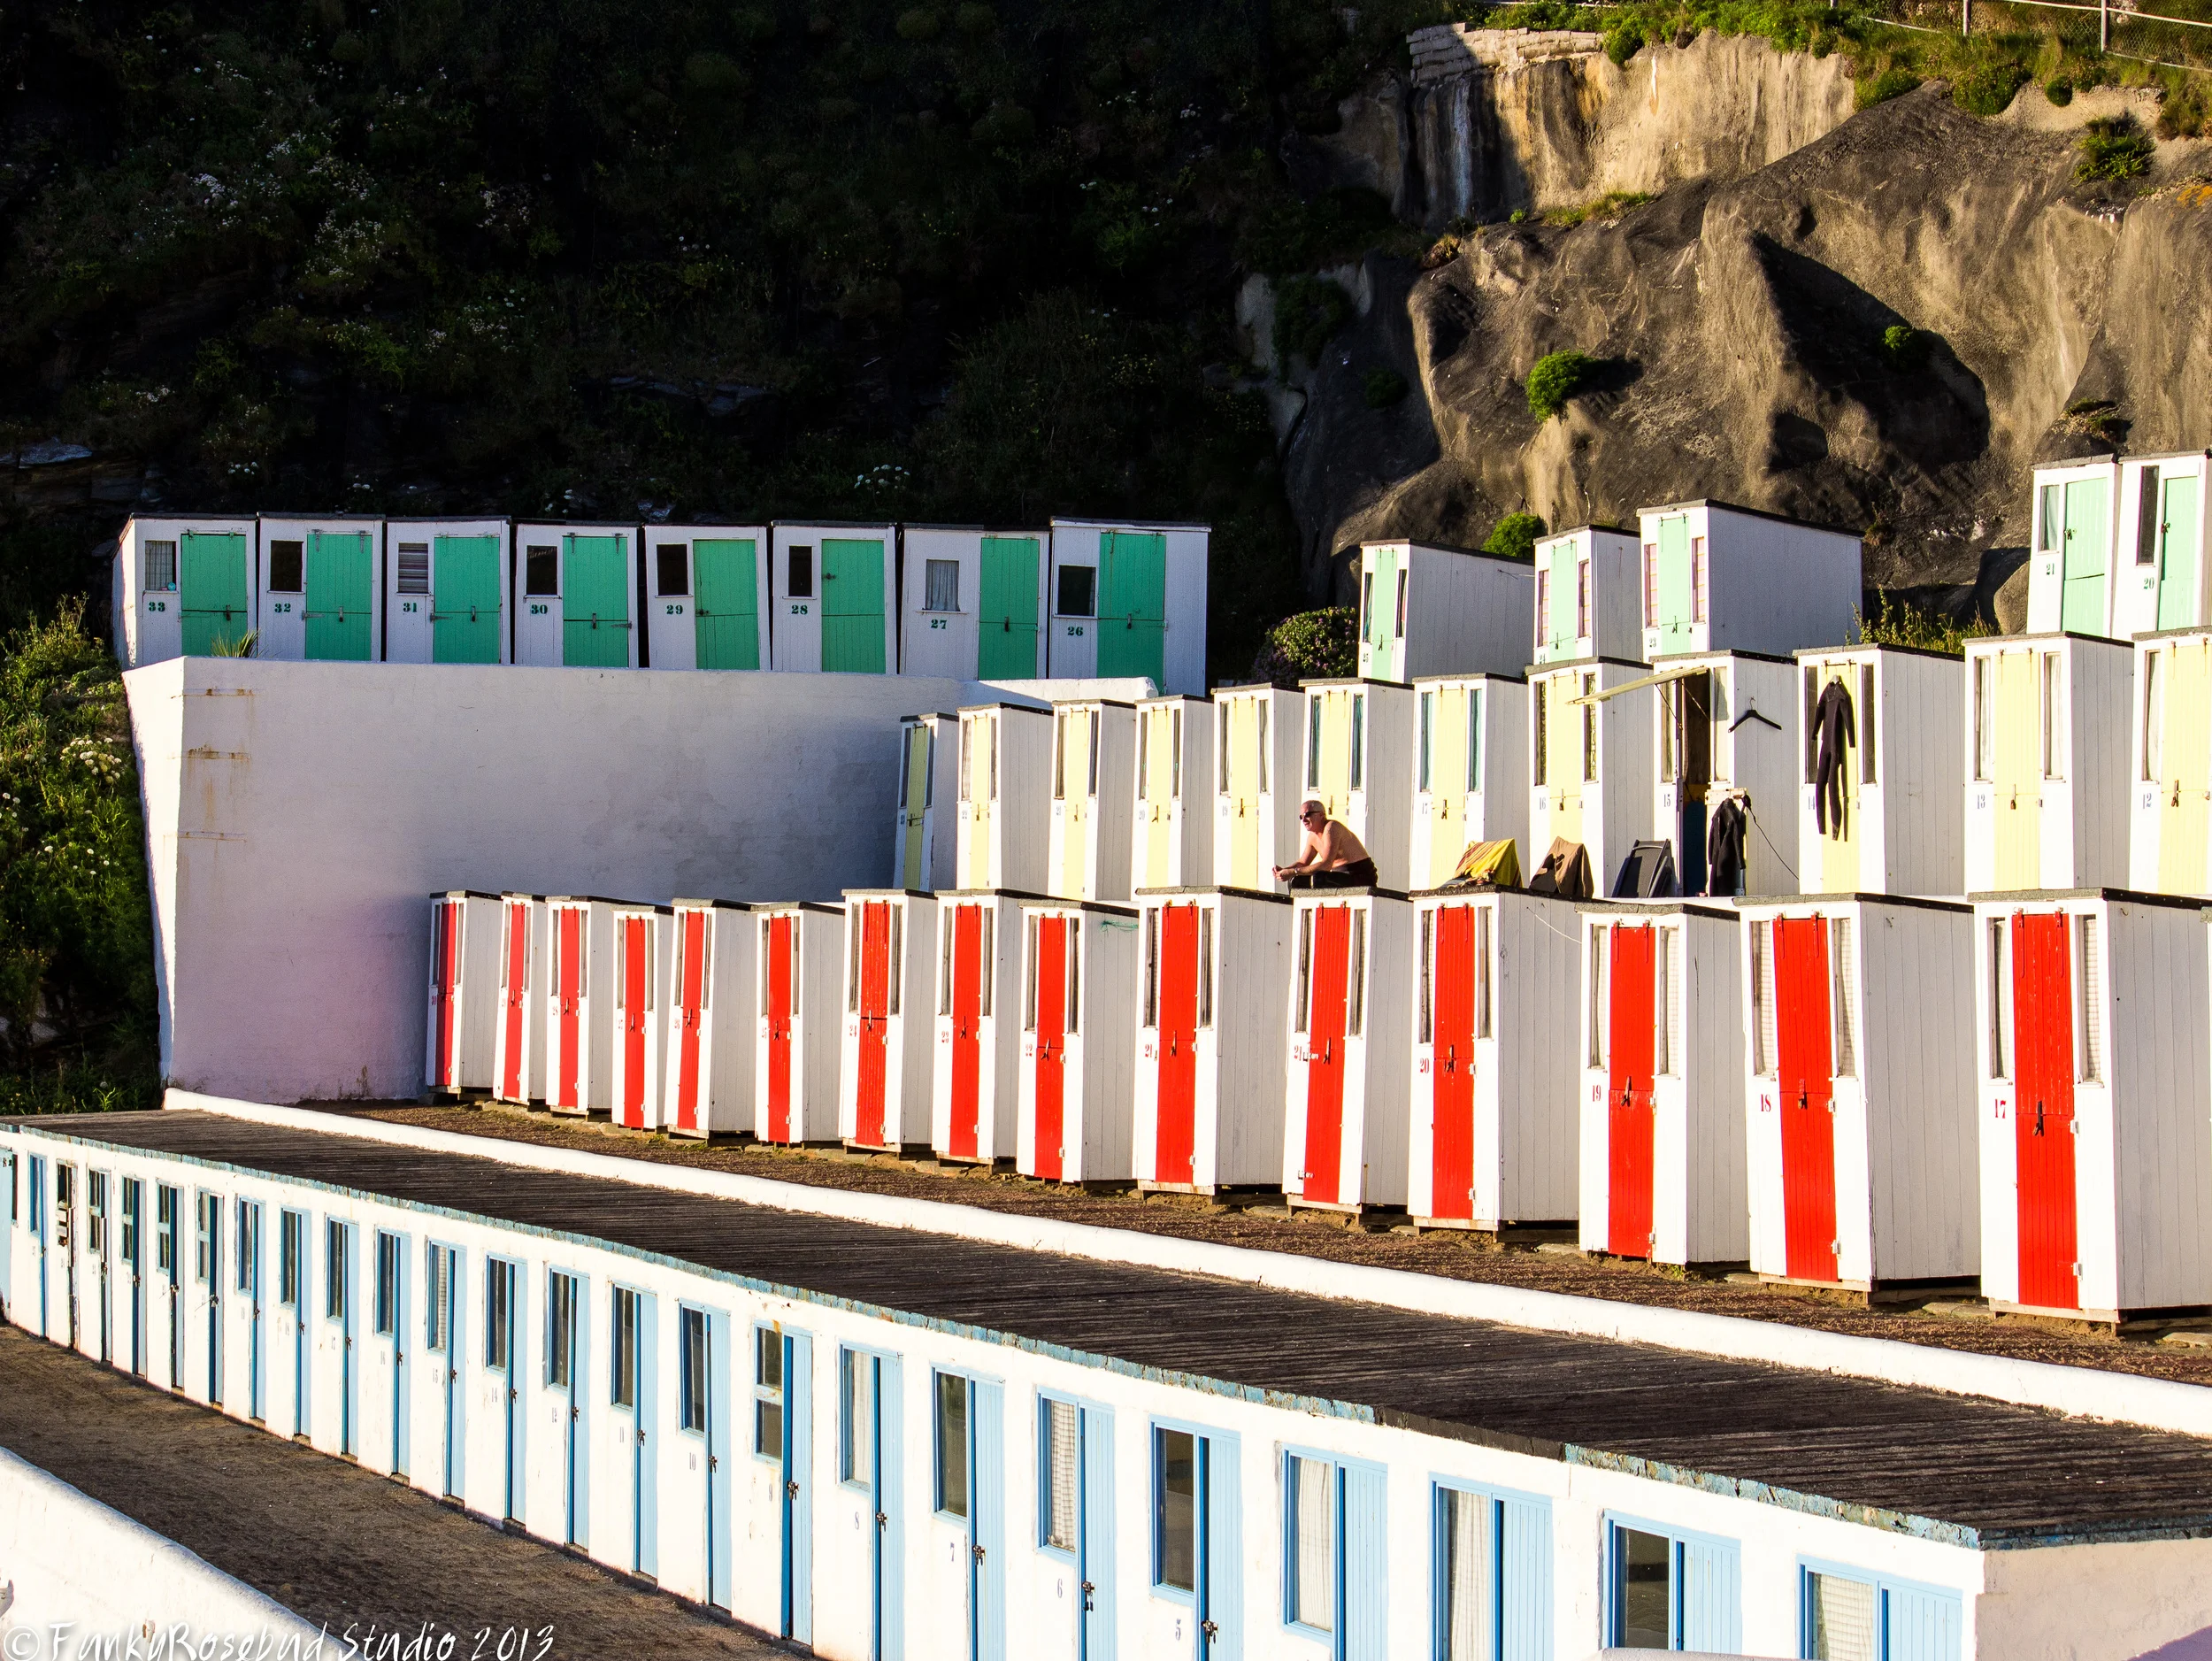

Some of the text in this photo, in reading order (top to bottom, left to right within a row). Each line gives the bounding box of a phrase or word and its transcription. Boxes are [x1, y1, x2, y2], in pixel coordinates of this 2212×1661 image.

[2046, 563, 2055, 575] 21
[2143, 577, 2154, 590] 20
[149, 602, 165, 612] 33
[274, 603, 291, 613] 32
[403, 603, 418, 612] 31
[531, 604, 549, 614] 30
[666, 604, 684, 615] 29
[791, 604, 809, 615] 28
[931, 619, 948, 629] 27
[1067, 626, 1084, 636] 26
[1540, 796, 1546, 810] 16
[1663, 794, 1671, 807] 15
[1977, 794, 1985, 810] 13
[2142, 793, 2152, 809] 12
[1025, 1043, 1033, 1057] 22
[1419, 1057, 1429, 1073] 20
[1592, 1085, 1601, 1102] 19
[1761, 1094, 1771, 1111] 18
[1994, 1099, 2006, 1119] 17
[689, 1452, 696, 1471] 10
[855, 1511, 859, 1530] 8
[949, 1542, 955, 1562] 7
[1057, 1579, 1063, 1598] 6
[1175, 1619, 1181, 1641] 5
